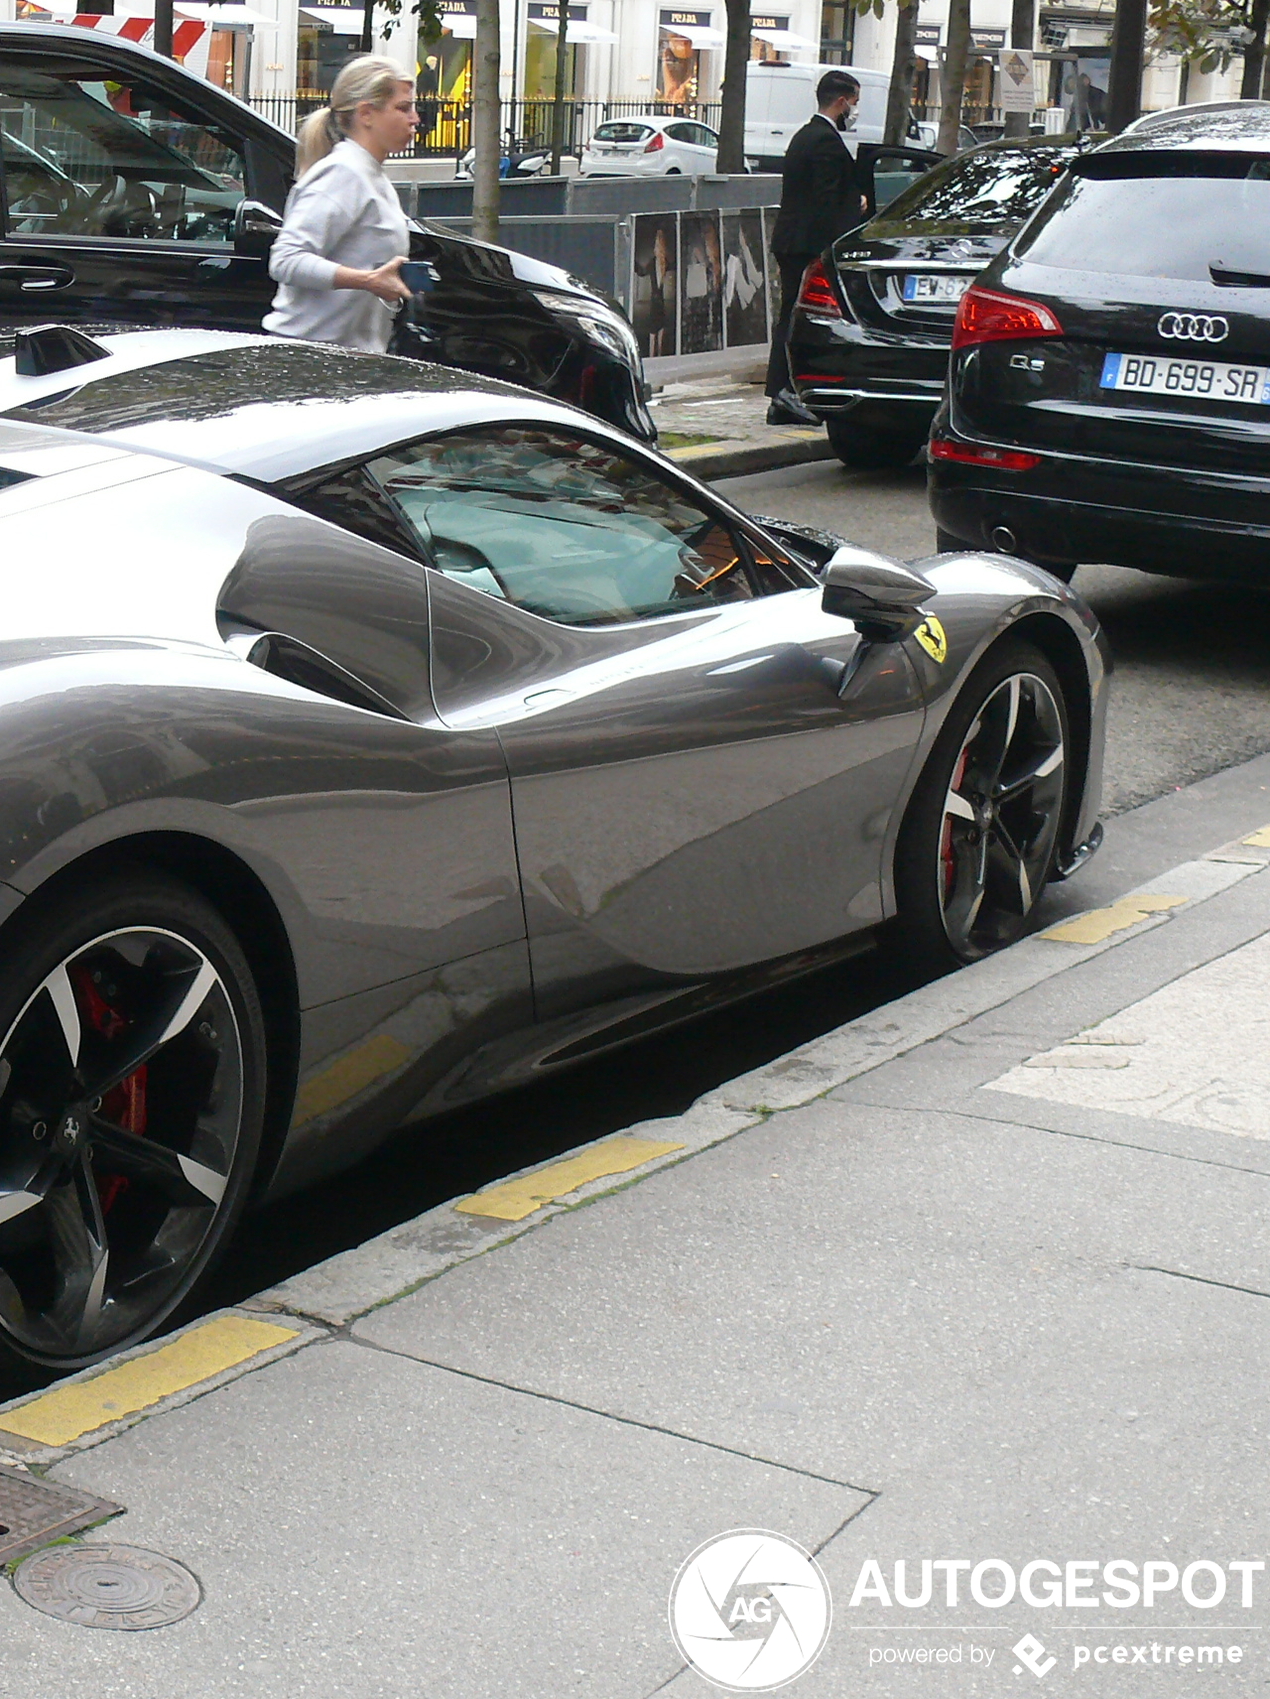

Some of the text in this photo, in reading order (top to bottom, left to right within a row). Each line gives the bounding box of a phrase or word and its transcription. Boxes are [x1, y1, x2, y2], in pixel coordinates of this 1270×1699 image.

[436, 1, 466, 12] RADA
[1010, 354, 1045, 372] Q5
[1123, 359, 1259, 399] BD-699-SR
